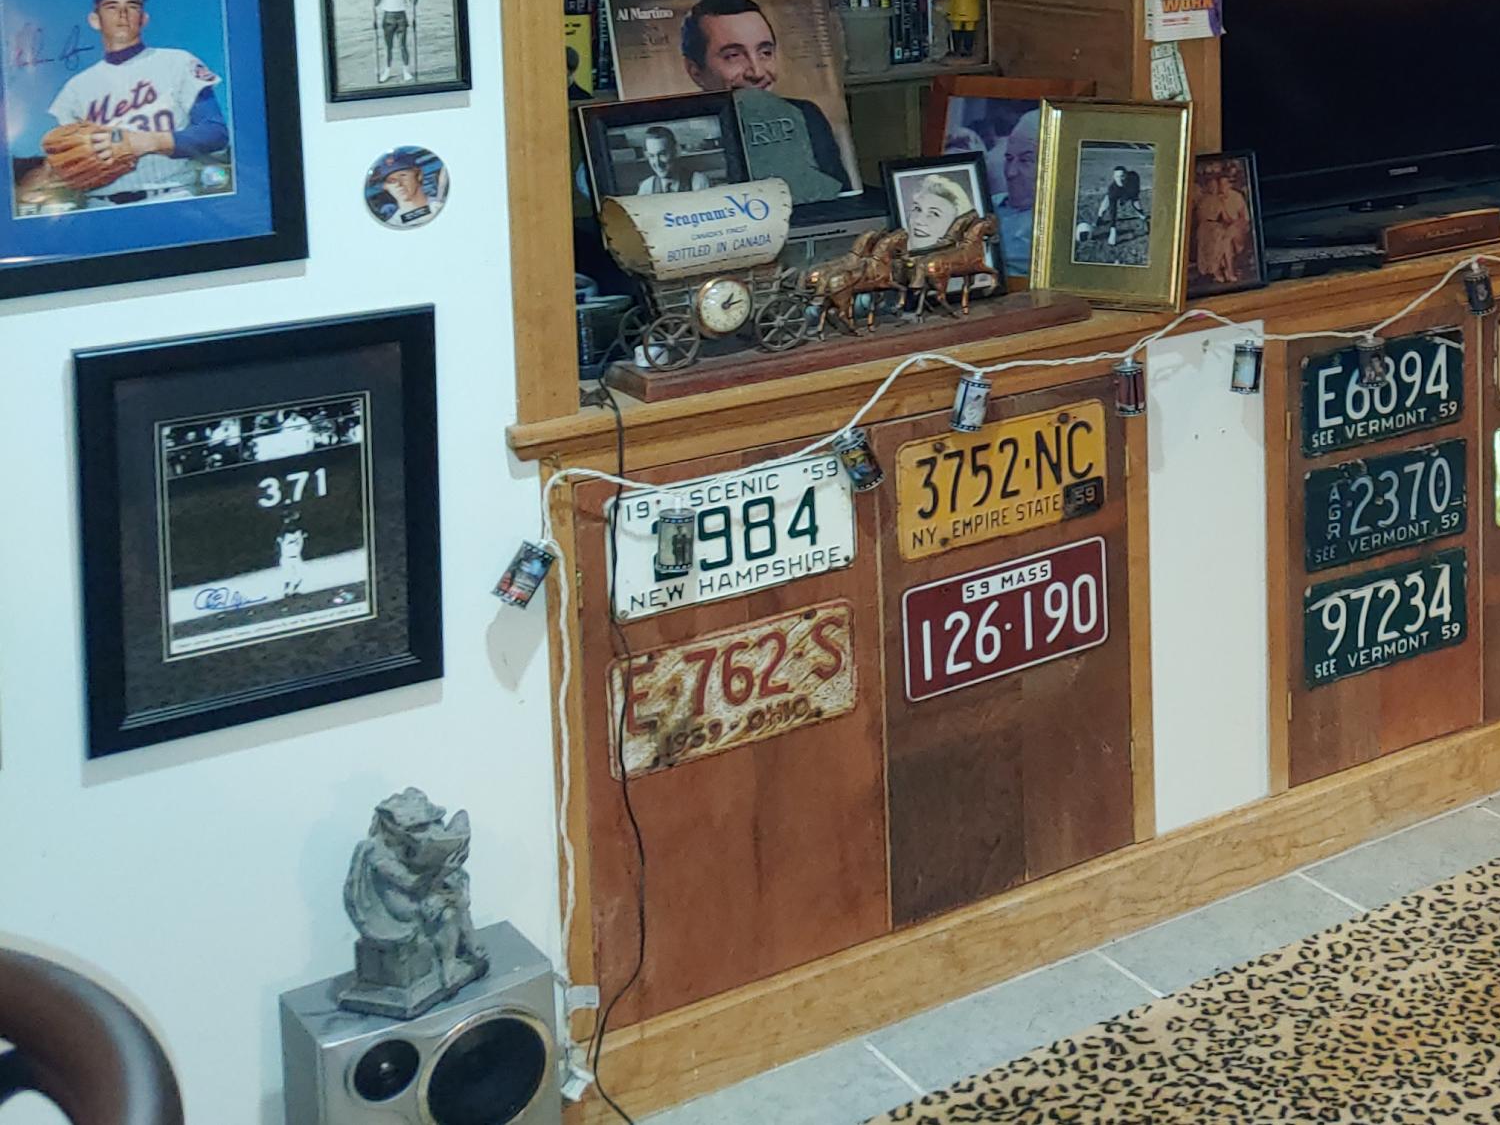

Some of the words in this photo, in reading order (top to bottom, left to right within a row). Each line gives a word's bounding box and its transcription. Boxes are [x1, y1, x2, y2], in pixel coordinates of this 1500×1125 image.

[615, 8, 628, 21] Al
[630, 5, 674, 20] Martino
[86, 78, 159, 125] Mets
[750, 118, 794, 146] RIP
[663, 207, 737, 229] Seagram's
[723, 192, 770, 221] VO
[666, 245, 711, 263] BOTTLED
[716, 241, 727, 253] IN
[733, 234, 772, 251] CANADA
[1311, 430, 1336, 449] SEE
[1343, 407, 1428, 441] VERMONT
[1438, 400, 1459, 419] 59
[256, 465, 329, 511] 3.71
[689, 473, 780, 508] SCENIC
[1348, 455, 1453, 538] 2370
[910, 525, 939, 550] NY
[951, 508, 1011, 539] EMPIRE
[1015, 492, 1061, 522] STATE
[1074, 486, 1097, 505] 59
[1314, 546, 1337, 565] SEE
[1347, 520, 1430, 557] VERMONT
[1440, 512, 1461, 530] 59
[630, 581, 686, 612] NEW
[699, 546, 843, 594] HAMPSHIRE
[964, 577, 993, 600] 59
[1000, 564, 1051, 591] MASS
[1321, 563, 1453, 658] 97234
[1314, 659, 1338, 680] SEE
[1346, 631, 1430, 669] VERMONT
[1441, 622, 1462, 642] 59
[749, 694, 812, 732] OHIO
